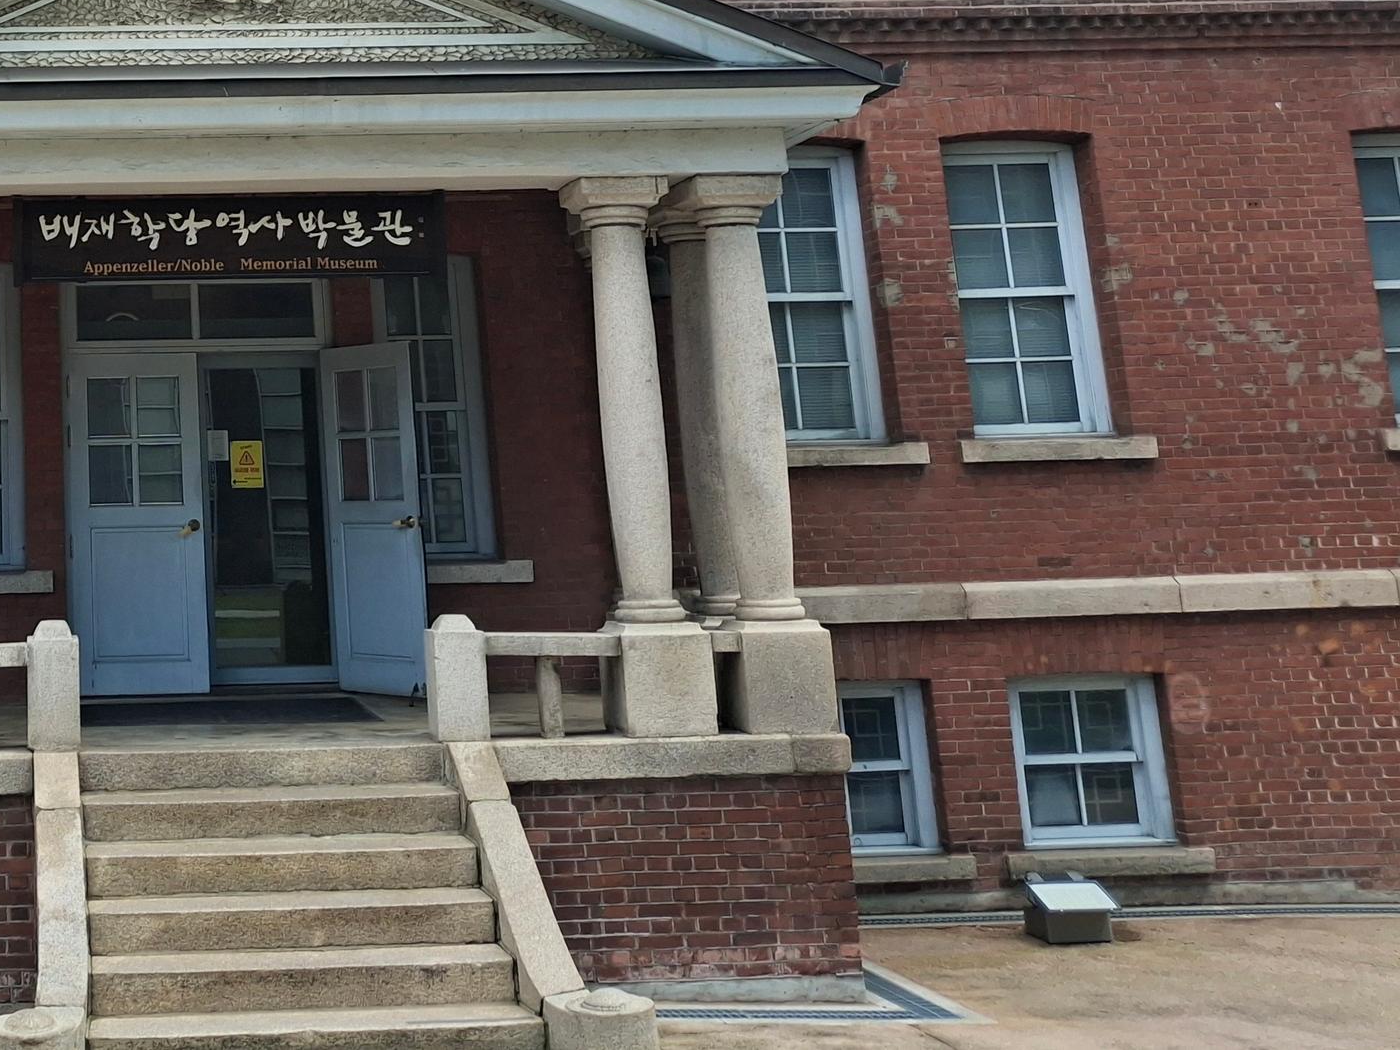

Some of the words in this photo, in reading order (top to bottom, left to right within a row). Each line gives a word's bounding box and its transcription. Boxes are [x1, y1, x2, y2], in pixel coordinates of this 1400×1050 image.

[84, 258, 225, 275] Appenzeller/Noble
[240, 257, 311, 270] Memorial
[316, 257, 378, 270] Museum
